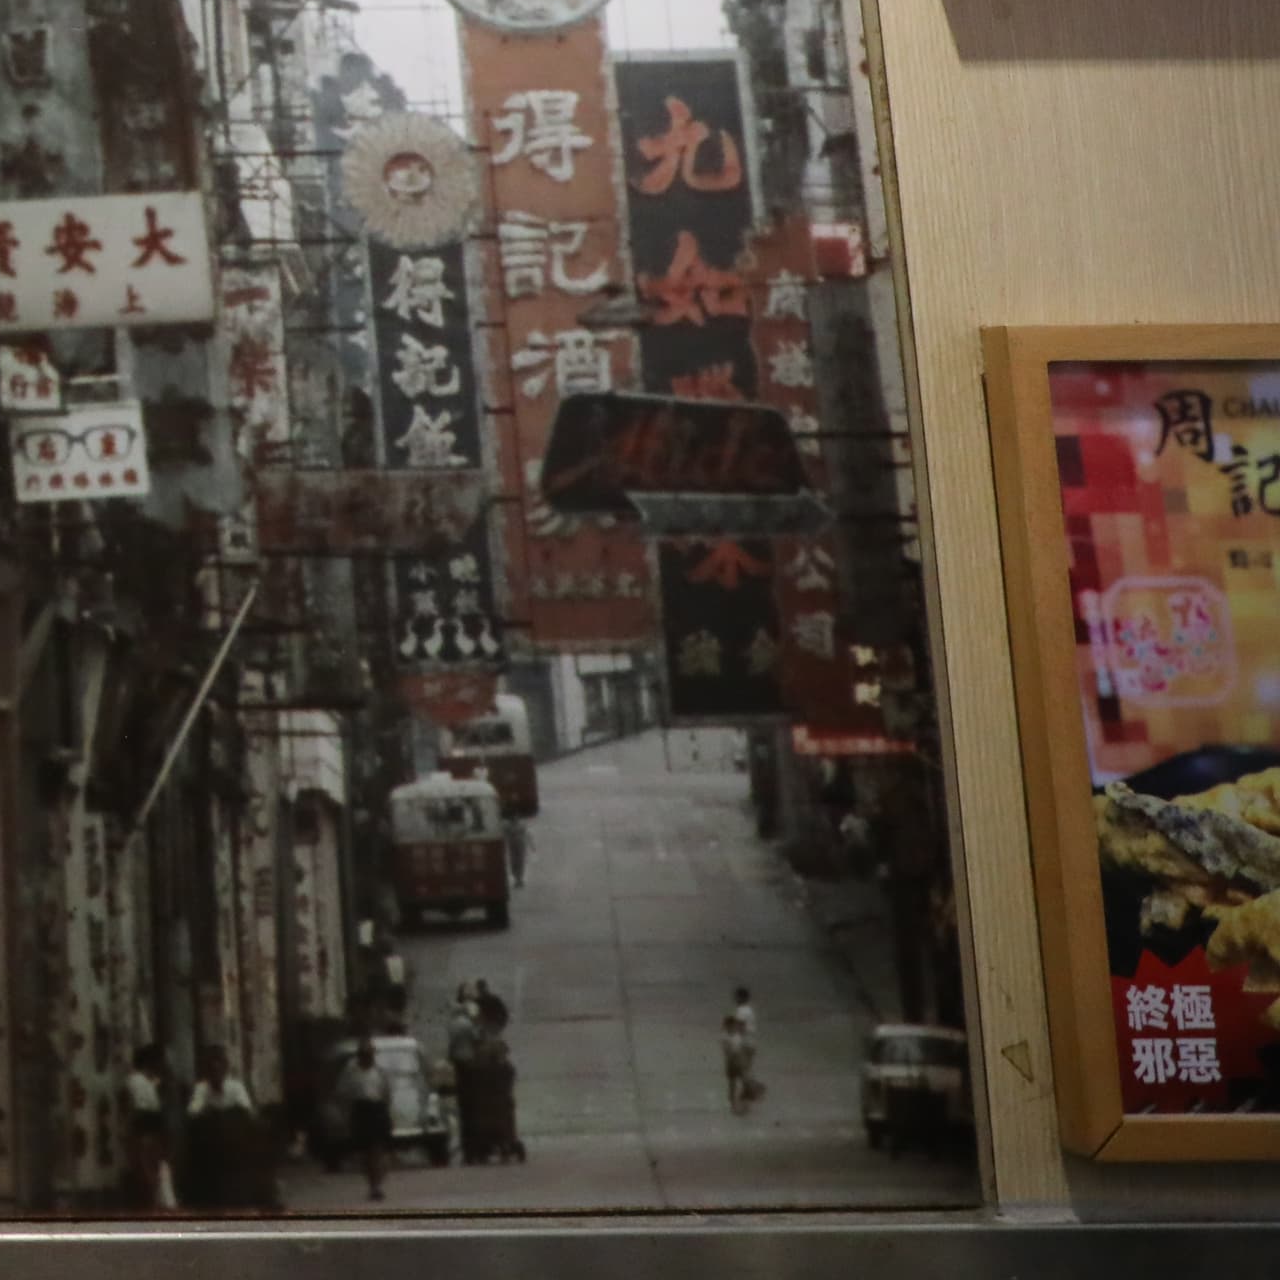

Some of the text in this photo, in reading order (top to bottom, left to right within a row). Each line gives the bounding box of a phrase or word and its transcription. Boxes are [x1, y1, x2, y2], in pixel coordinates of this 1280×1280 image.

[492, 89, 612, 535] 得記酒
[1126, 983, 1216, 1031] 終極
[1131, 1037, 1223, 1084] 邪惡
